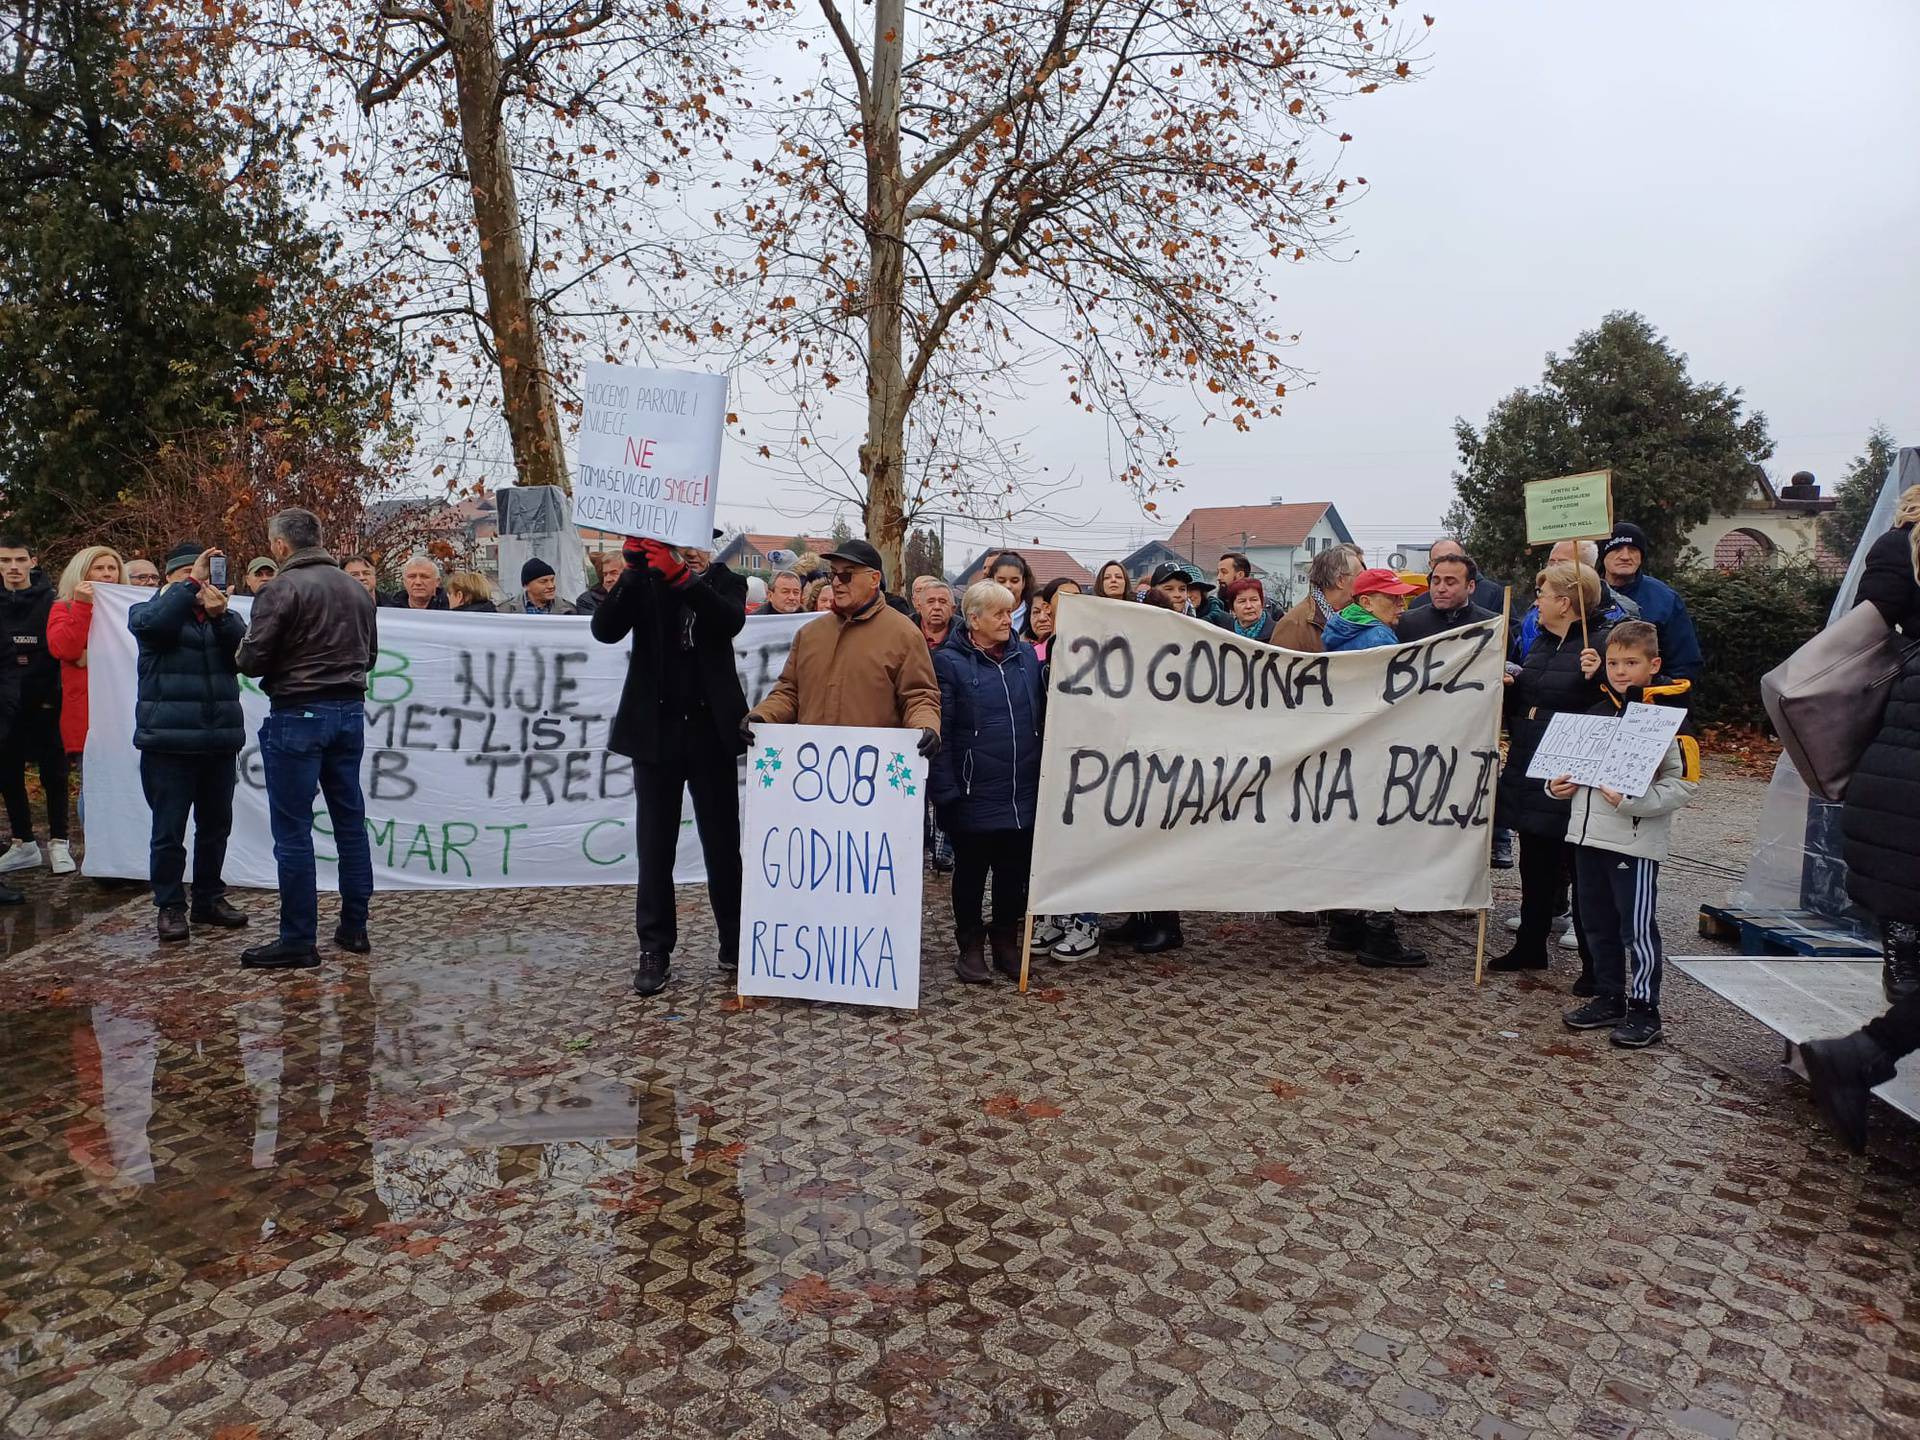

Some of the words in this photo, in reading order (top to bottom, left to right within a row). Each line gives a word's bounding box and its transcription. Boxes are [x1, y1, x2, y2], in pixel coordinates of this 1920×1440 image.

[636, 387, 687, 415] PARKOVE
[693, 392, 698, 416] I
[624, 436, 657, 468] NE
[577, 496, 624, 524] KOZARI
[630, 501, 678, 537] PUTEVI
[455, 647, 588, 714] NIJE
[1056, 636, 1134, 699] 20
[1147, 640, 1334, 710] GODINA
[1382, 627, 1495, 705] BEZ
[362, 703, 617, 751] METLIŠT
[466, 751, 636, 805] TREB
[793, 742, 879, 806] 808
[1062, 748, 1272, 830] POMAKA
[1291, 748, 1358, 824] NA
[1377, 744, 1500, 829] BOLJE
[762, 827, 897, 895] GODINA
[751, 921, 898, 990] RESNIKA
